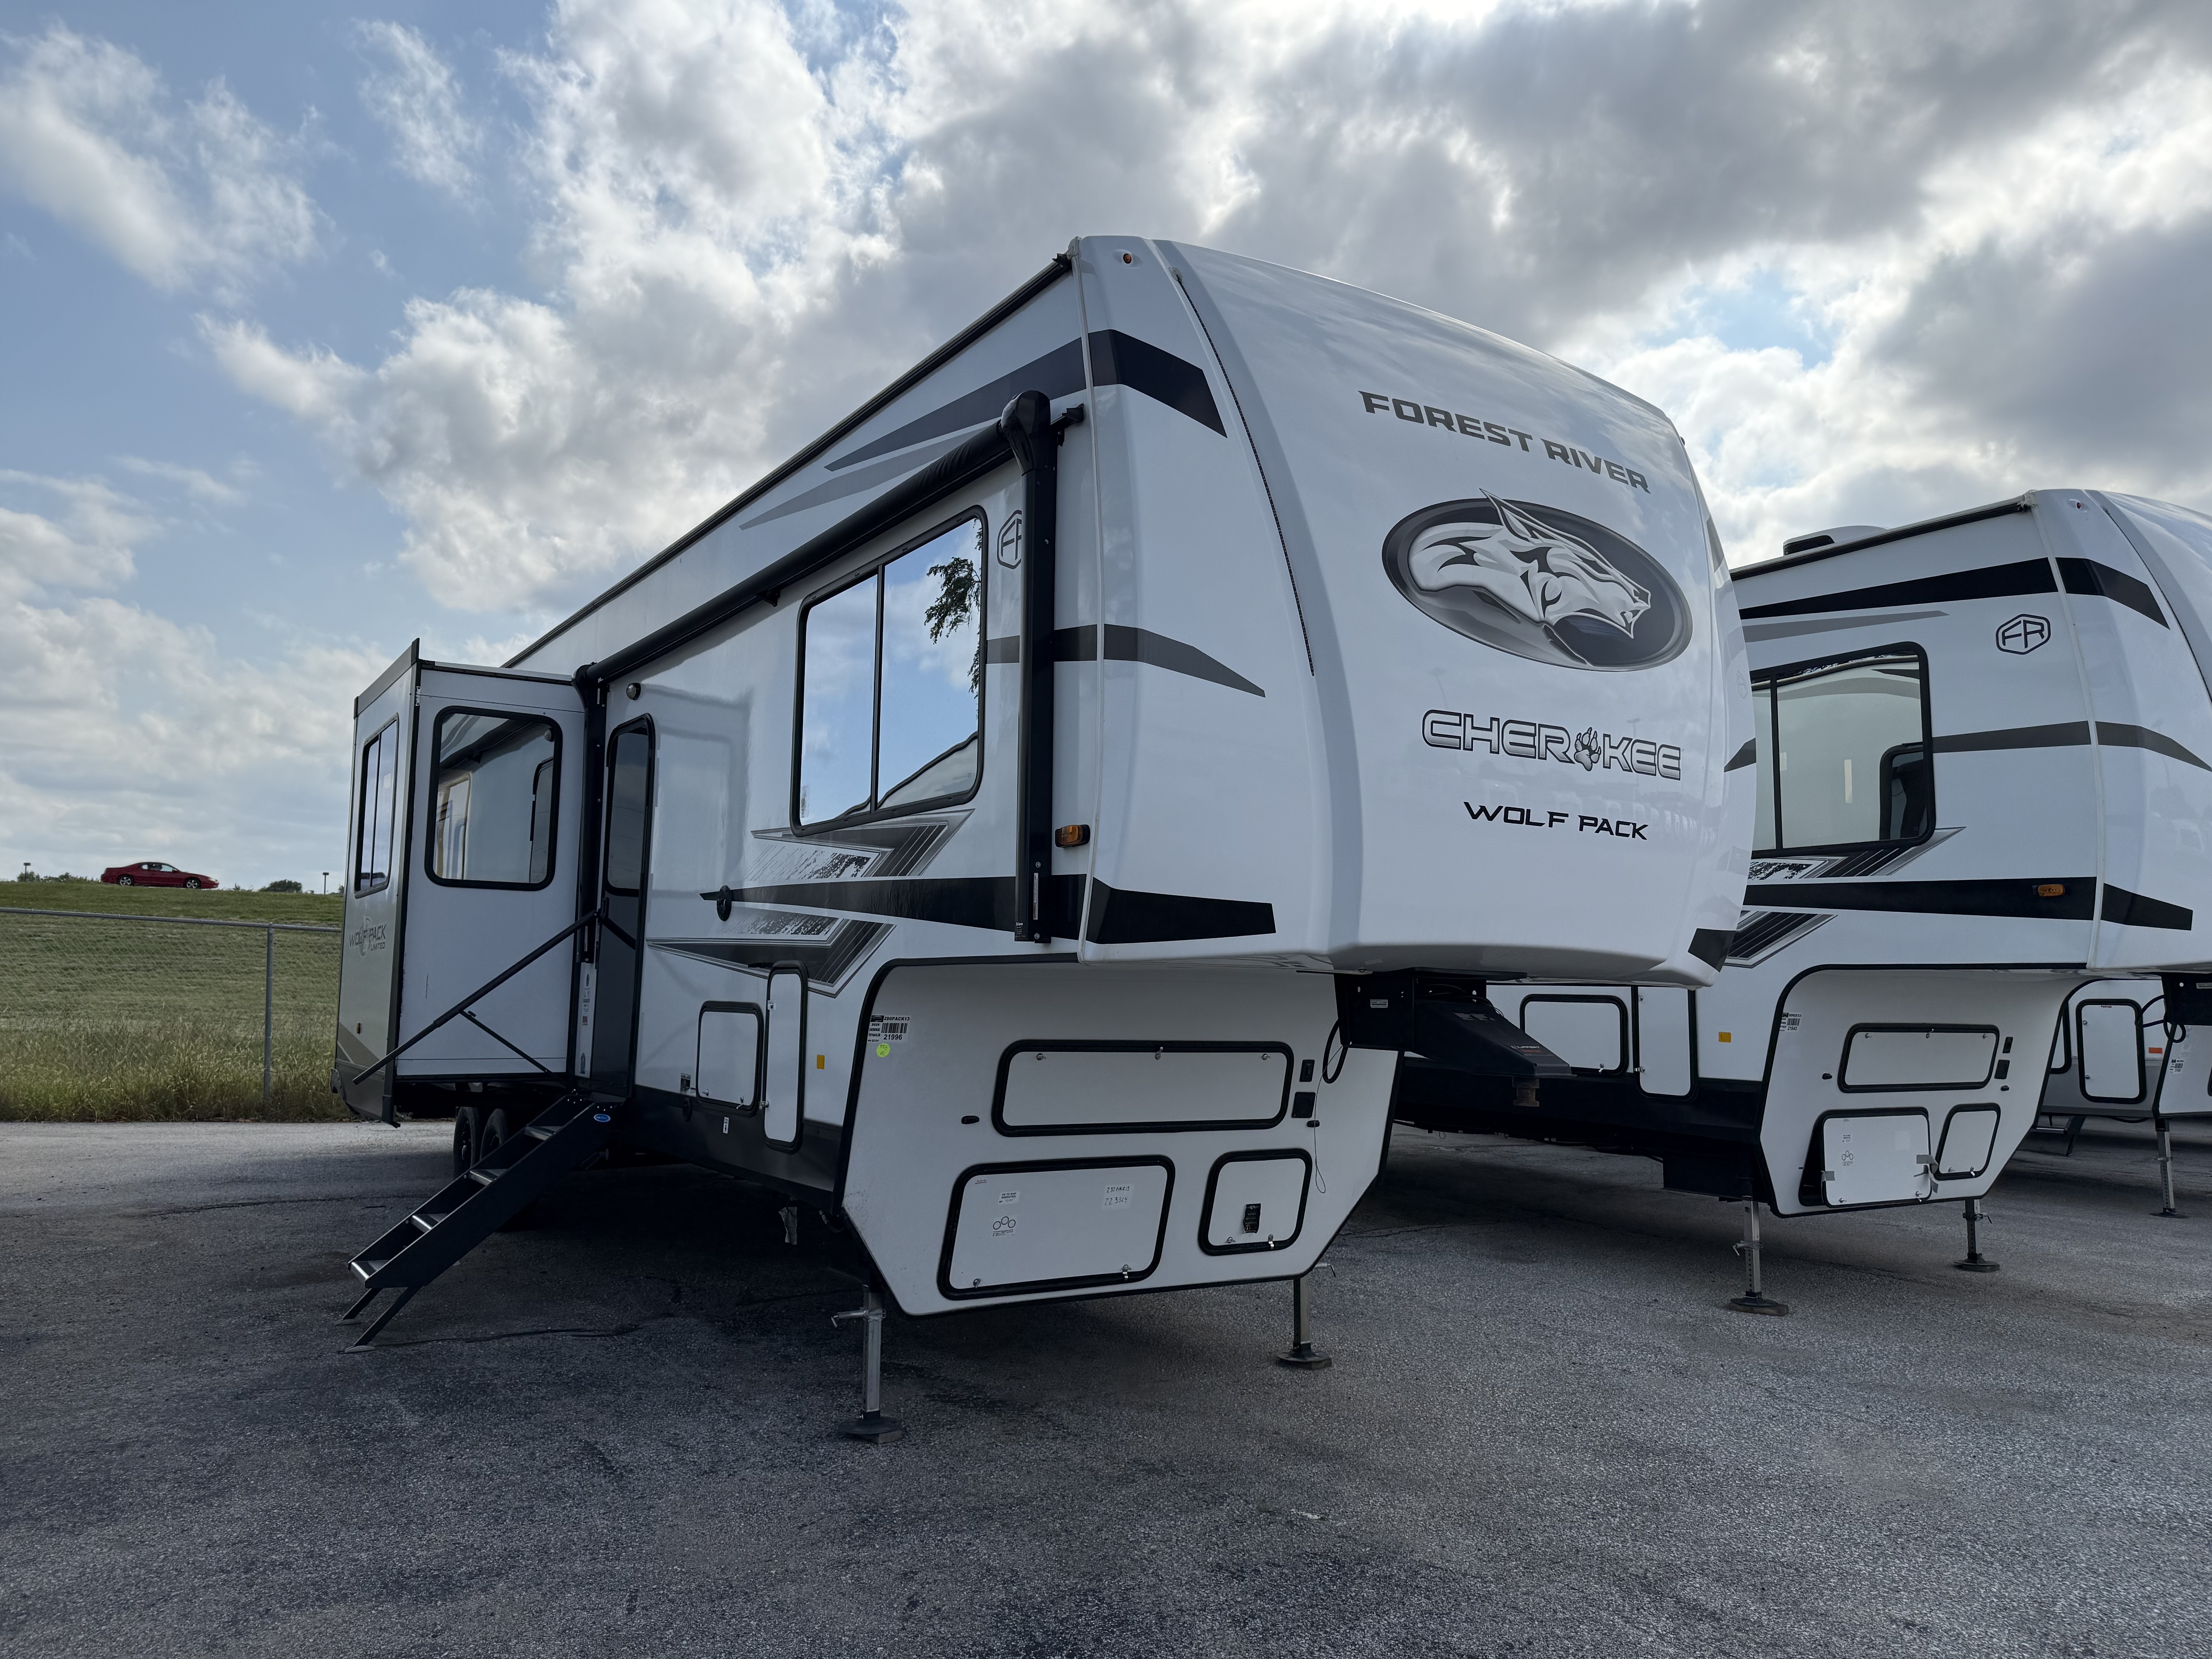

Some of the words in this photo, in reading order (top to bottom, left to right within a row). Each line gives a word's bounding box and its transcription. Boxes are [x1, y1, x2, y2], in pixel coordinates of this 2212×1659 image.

[1358, 391, 1533, 452] FOREST
[1541, 438, 1651, 494] RIVER
[1463, 801, 1569, 828] WOLF
[1578, 815, 1649, 840] PACK
[349, 929, 368, 947] WOLF
[369, 924, 386, 942] PACK
[371, 942, 385, 951] LIMITED
